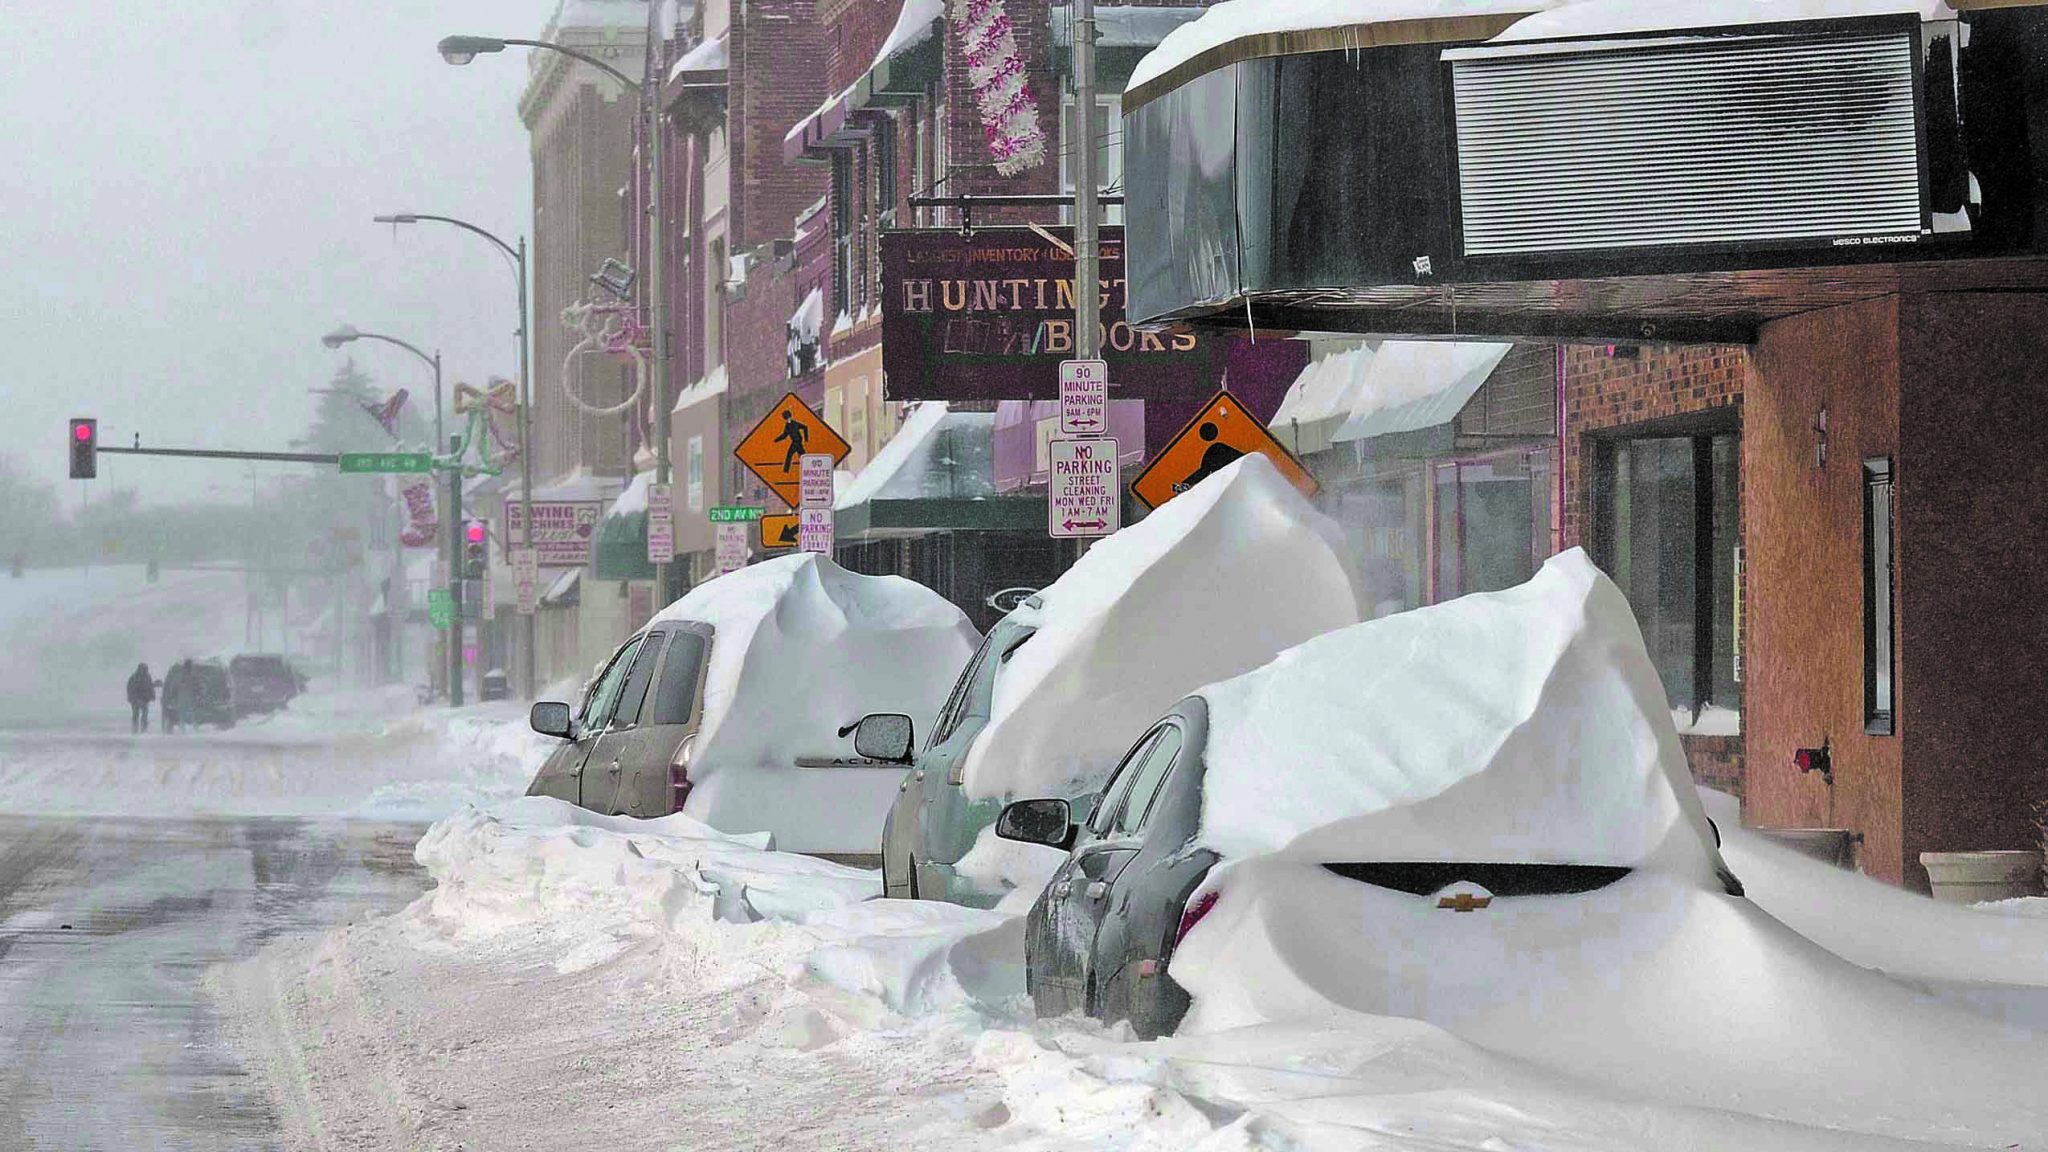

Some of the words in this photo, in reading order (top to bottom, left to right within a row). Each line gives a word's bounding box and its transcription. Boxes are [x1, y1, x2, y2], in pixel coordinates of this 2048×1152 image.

[1076, 367, 1090, 378] 90
[1064, 381, 1103, 392] MINUTE
[1064, 394, 1103, 405] PARKING
[1075, 446, 1092, 459] NO
[811, 460, 823, 468] 90
[1056, 460, 1112, 474] PARKING
[803, 469, 830, 478] MINUTE
[803, 479, 830, 487] PARKING
[1068, 476, 1100, 486] STREET
[1063, 486, 1106, 496] CLEANING
[1055, 497, 1074, 507] MON
[1079, 496, 1096, 506] WED
[1100, 496, 1115, 505] FRI
[511, 506, 574, 518] SWING
[711, 509, 731, 520] 2ND
[734, 509, 746, 520] AV
[810, 513, 823, 523] NO
[511, 519, 574, 529] MCHINES
[801, 524, 832, 534] PARKING
